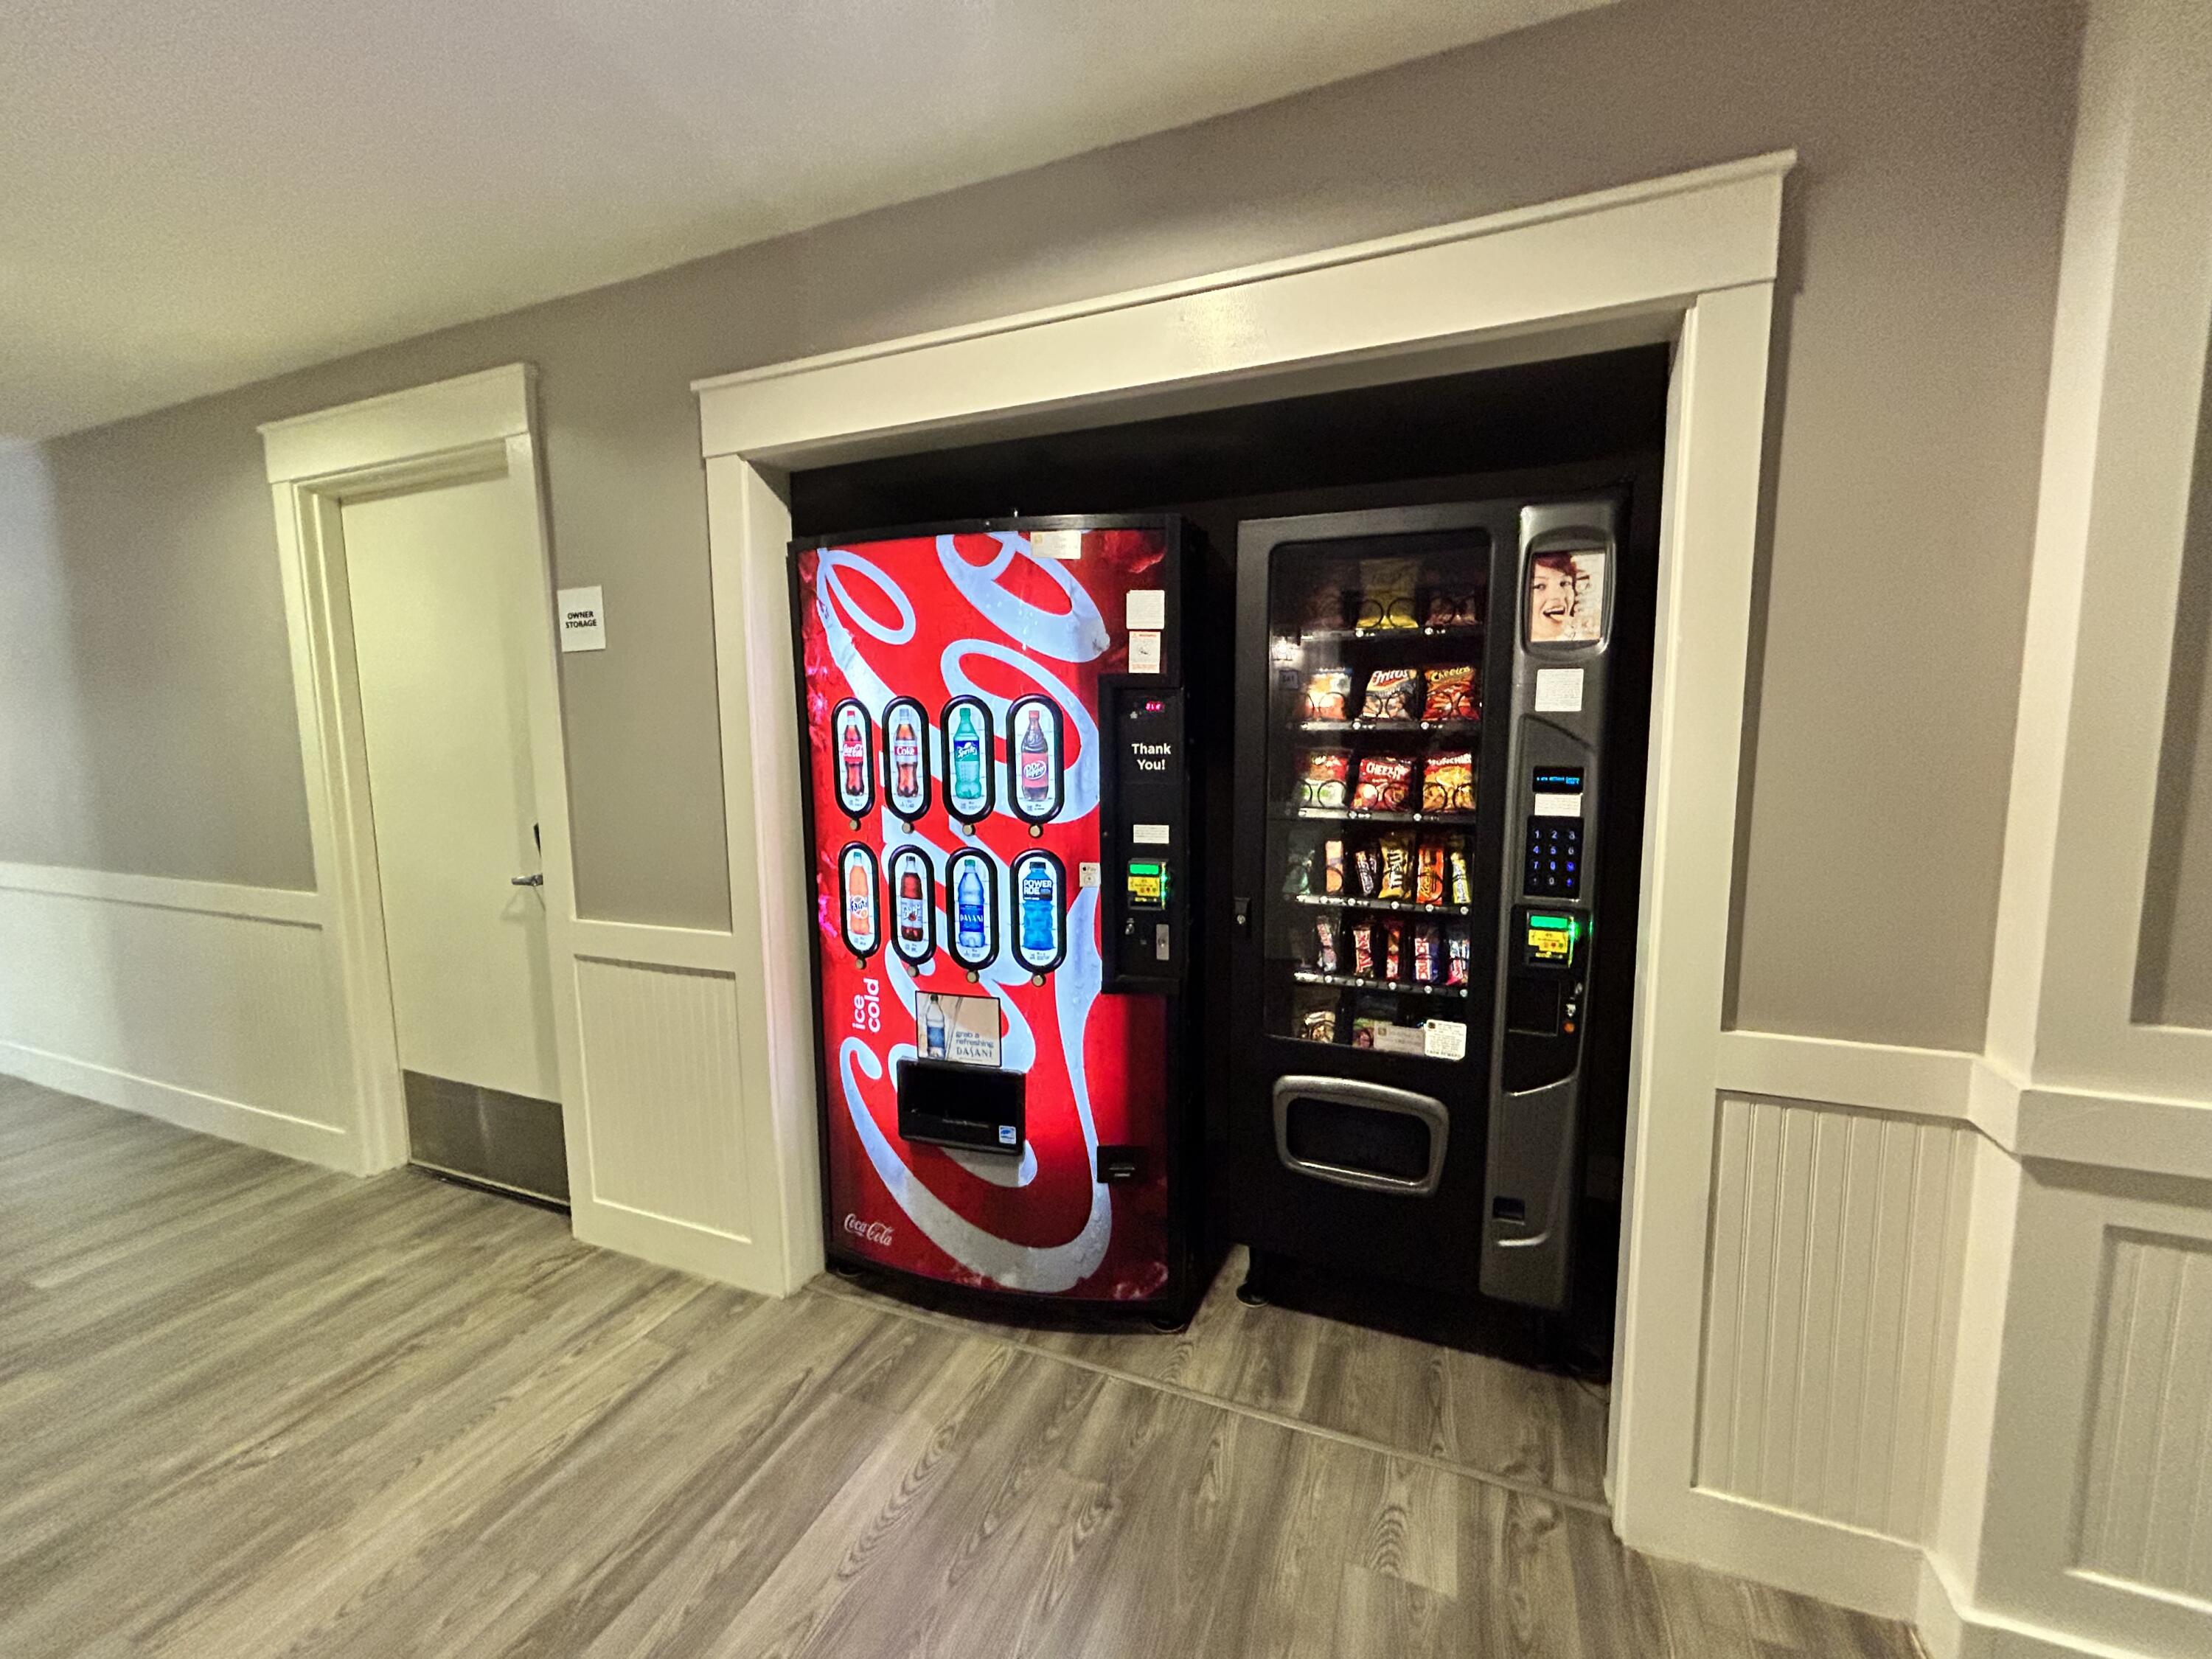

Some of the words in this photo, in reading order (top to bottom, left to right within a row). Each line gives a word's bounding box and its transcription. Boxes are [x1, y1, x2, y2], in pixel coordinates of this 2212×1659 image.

[567, 611, 594, 619] OWNER
[566, 619, 597, 628] STORAGE
[1372, 669, 1408, 686] Fritos
[897, 746, 914, 756] Coke
[1131, 742, 1172, 754] Thank
[1136, 759, 1166, 771] You!
[1535, 830, 1540, 838] 1
[1551, 830, 1557, 839] 2
[1569, 831, 1575, 840] 3
[1534, 846, 1539, 854] 4
[1023, 880, 1052, 888] POWER
[863, 978, 881, 1032] cold
[852, 994, 866, 1029] ice
[956, 1038, 994, 1048] refreshing
[956, 1047, 992, 1057] DASANI
